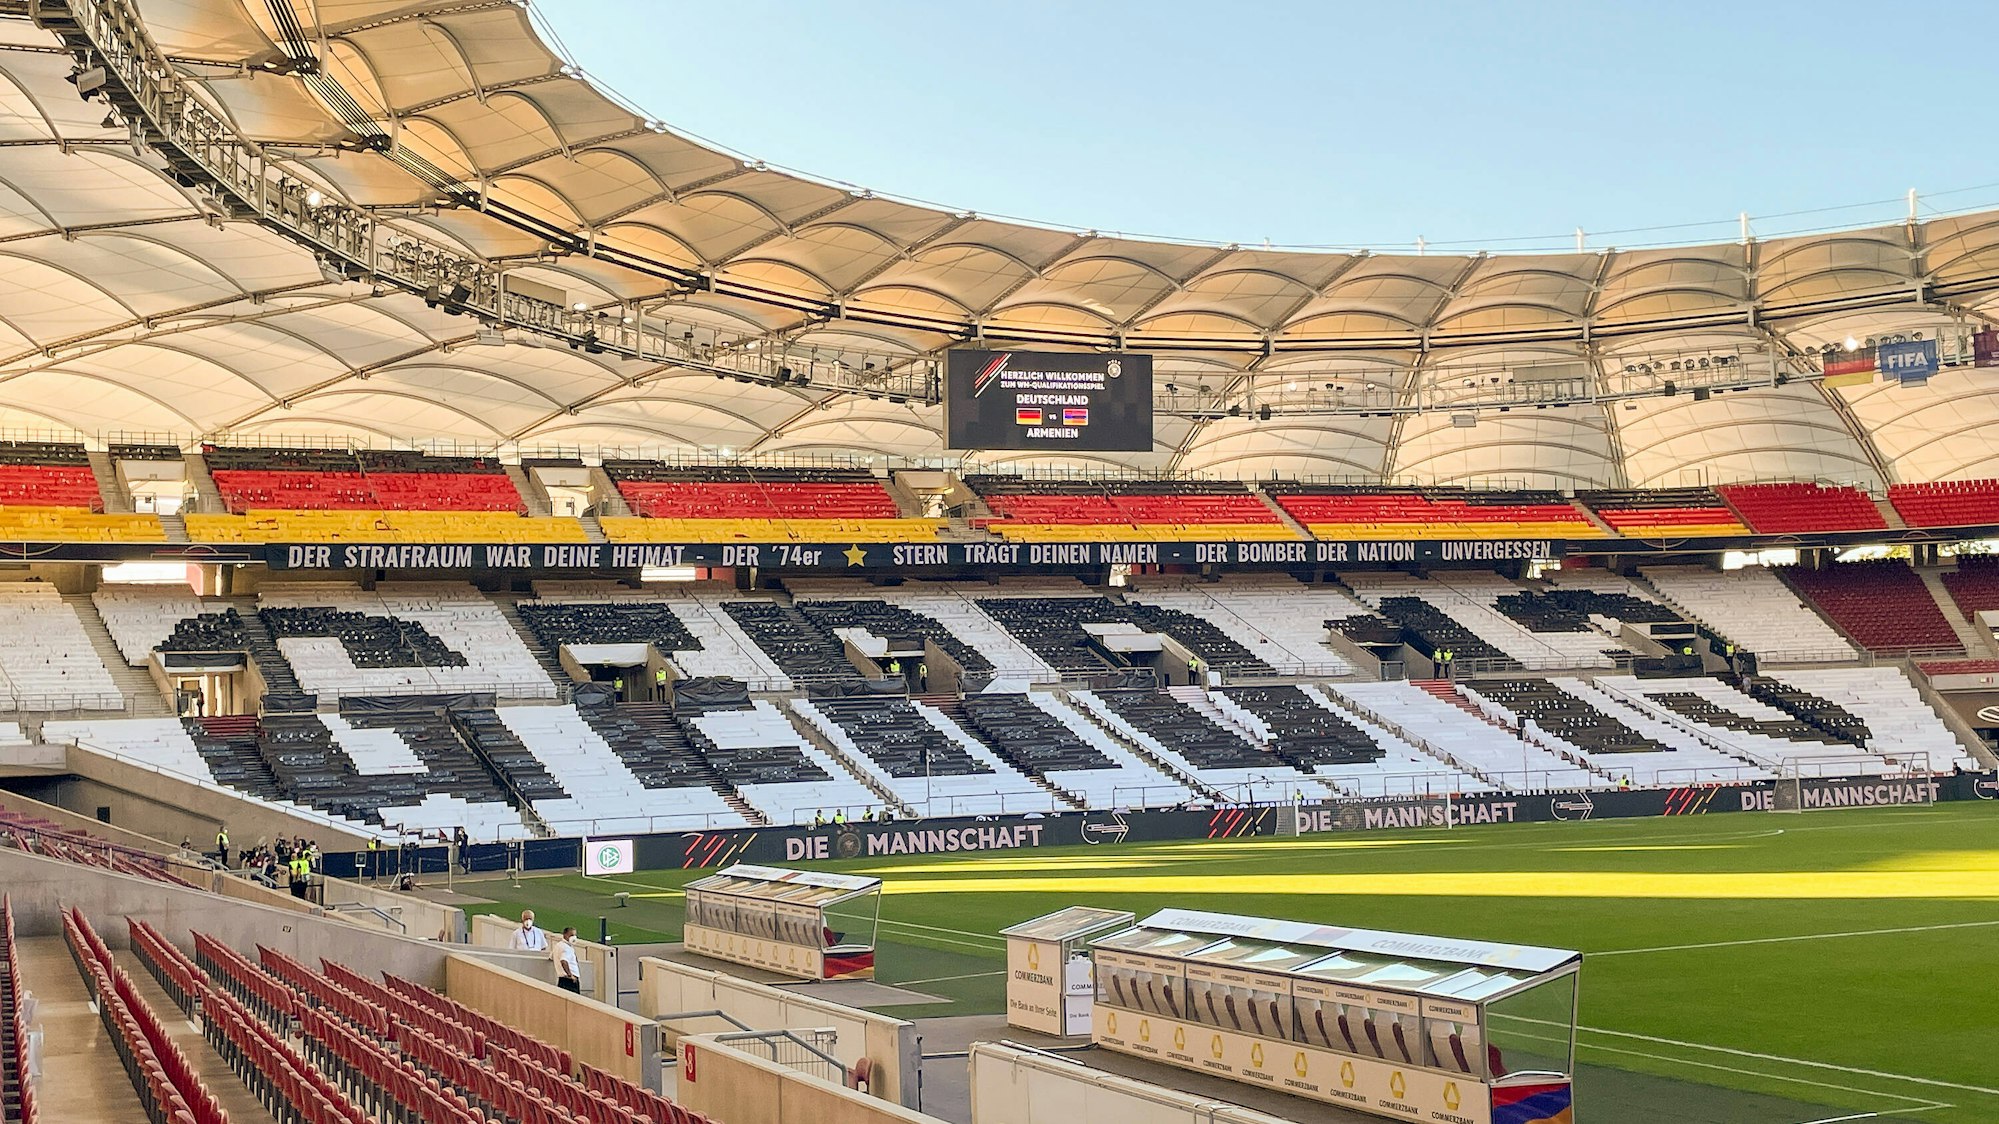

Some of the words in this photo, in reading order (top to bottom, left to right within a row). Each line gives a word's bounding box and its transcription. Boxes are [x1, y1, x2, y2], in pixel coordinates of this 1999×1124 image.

[1887, 352, 1928, 369] FIFA
[1000, 380, 1016, 389] ZUM
[1001, 371, 1044, 381] HERZLICH
[1045, 372, 1105, 382] WILLKOMMEN
[1016, 394, 1088, 406] DEUTSCHLAND
[1026, 428, 1079, 439] ARMENIEN
[288, 546, 331, 568] DER
[344, 546, 473, 568] STRAFRAUM
[486, 546, 532, 568] WAR
[543, 546, 600, 568] DEINE
[612, 546, 686, 567] HEIMAT
[722, 546, 760, 566] DER
[893, 545, 948, 565] STERN
[963, 542, 1020, 565] TRÄGT
[1029, 543, 1090, 564] DEINEN
[1100, 543, 1158, 563] NAMEN
[1195, 543, 1228, 562] DER
[1238, 542, 1307, 562] BOMBER
[1316, 542, 1348, 561] DER
[1357, 542, 1415, 561] NATION
[1441, 541, 1551, 560] UNVERGESSEN
[1740, 790, 1774, 811] DIE
[1802, 783, 1940, 808] MANNSCHAFT
[1299, 810, 1332, 833] DIE
[1364, 802, 1517, 830] MANNSCHAFT
[785, 835, 830, 861] DIE
[867, 825, 1043, 856] MANNSCHAFT
[1014, 970, 1054, 986] COMMERZBANK
[626, 1029, 632, 1049] 9
[687, 1052, 694, 1073] 8
[1284, 1078, 1319, 1092] COMMERZBANK
[1330, 1088, 1367, 1103] COMMERZBANK
[1379, 1099, 1419, 1115] COMMERZBANK
[1431, 1111, 1475, 1124] COMMERZBANK
